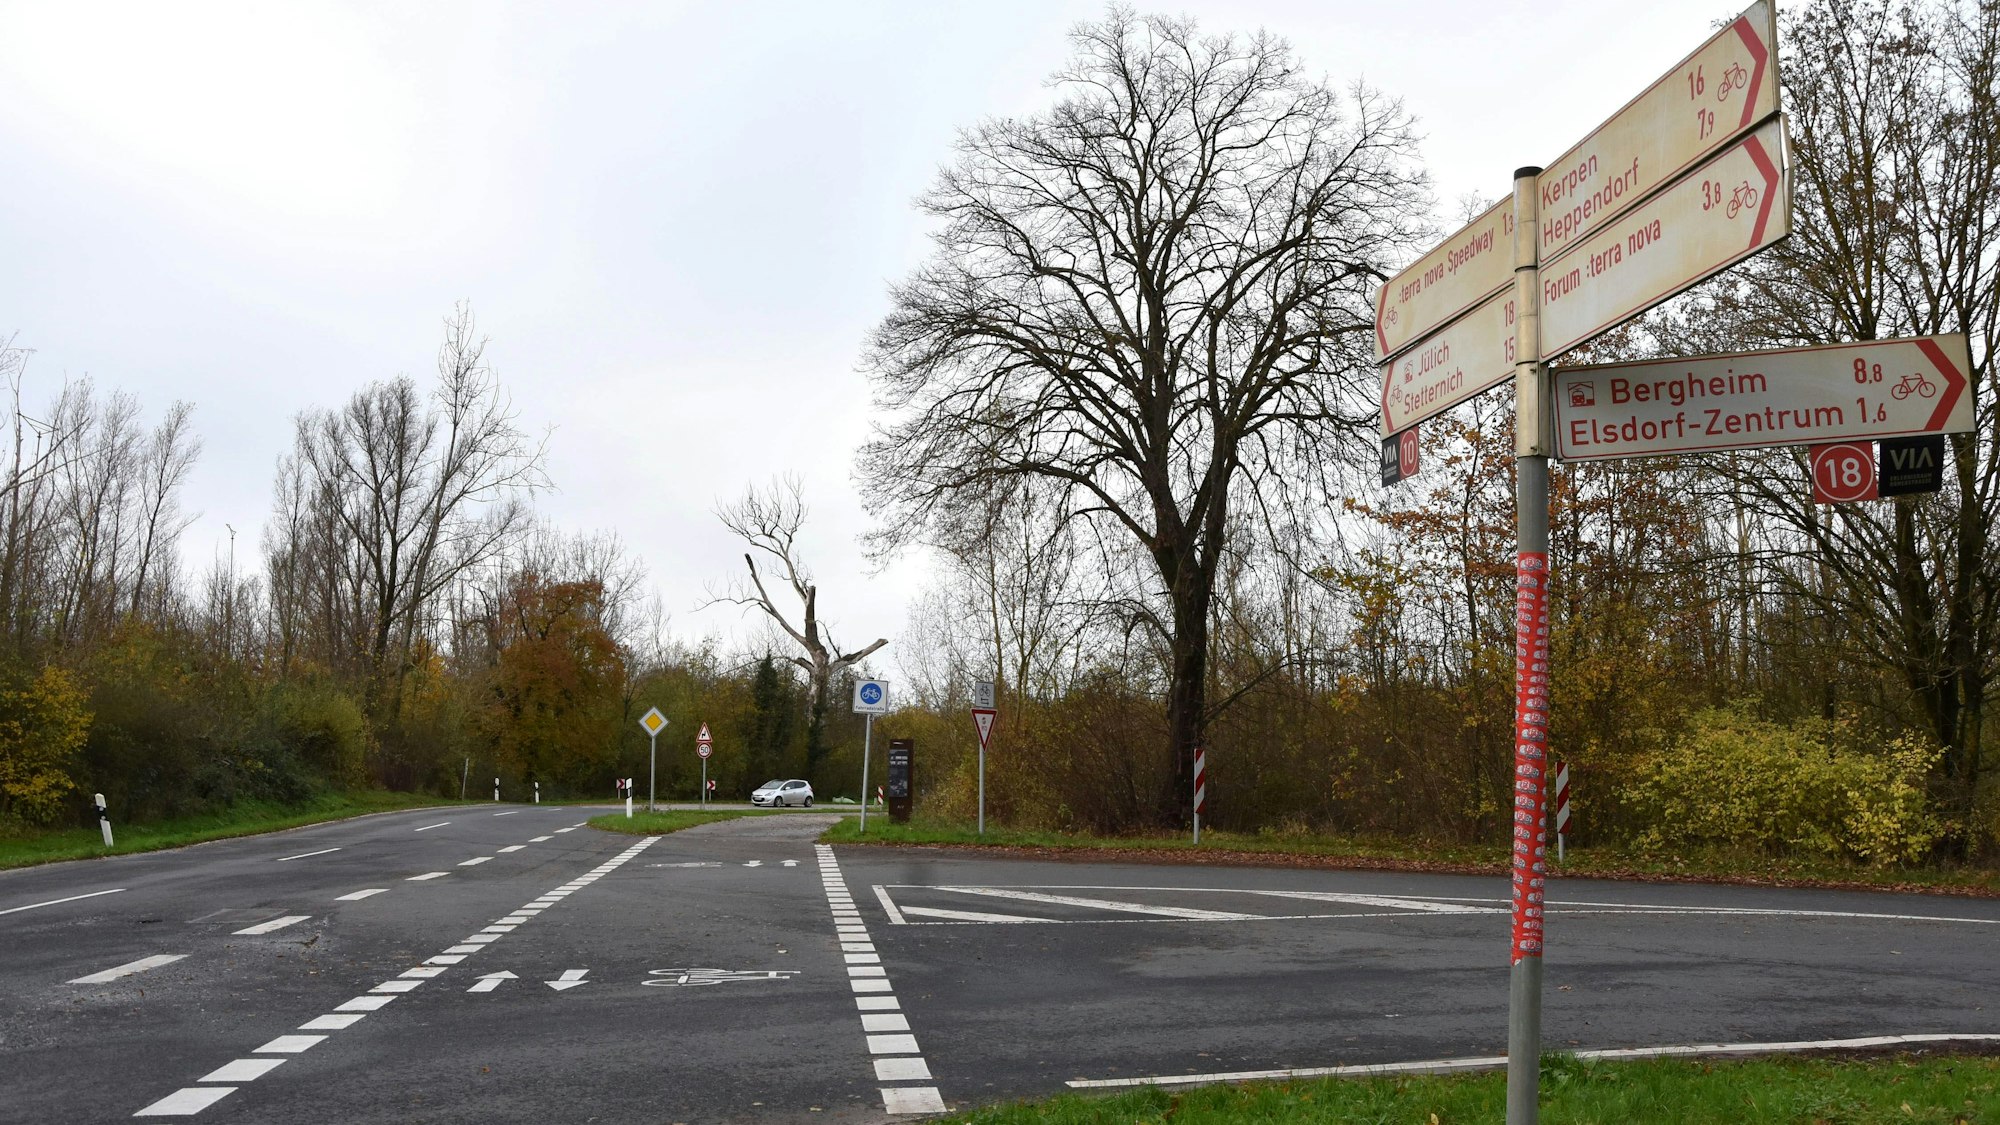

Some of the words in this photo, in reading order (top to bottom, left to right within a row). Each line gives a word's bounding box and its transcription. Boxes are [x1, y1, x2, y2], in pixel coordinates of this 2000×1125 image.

[1542, 154, 1598, 210] Kerpen
[1687, 65, 1705, 101] 16
[1543, 157, 1639, 247] Heppendorf
[1425, 262, 1444, 287] nova
[1447, 226, 1494, 275] Speedway
[1543, 267, 1581, 306] Forum
[1628, 217, 1662, 256] nova
[1418, 343, 1450, 377] Jülich
[1504, 300, 1515, 328] 18
[1403, 369, 1463, 415] Stetternich
[1504, 336, 1515, 364] 15
[1611, 370, 1767, 407] Bergheim
[1570, 404, 1844, 447] Elsdorf-Zentrum
[1383, 443, 1397, 465] VIA
[1403, 439, 1414, 466] 10
[1824, 457, 1862, 489] 18
[1890, 446, 1934, 471] VIA
